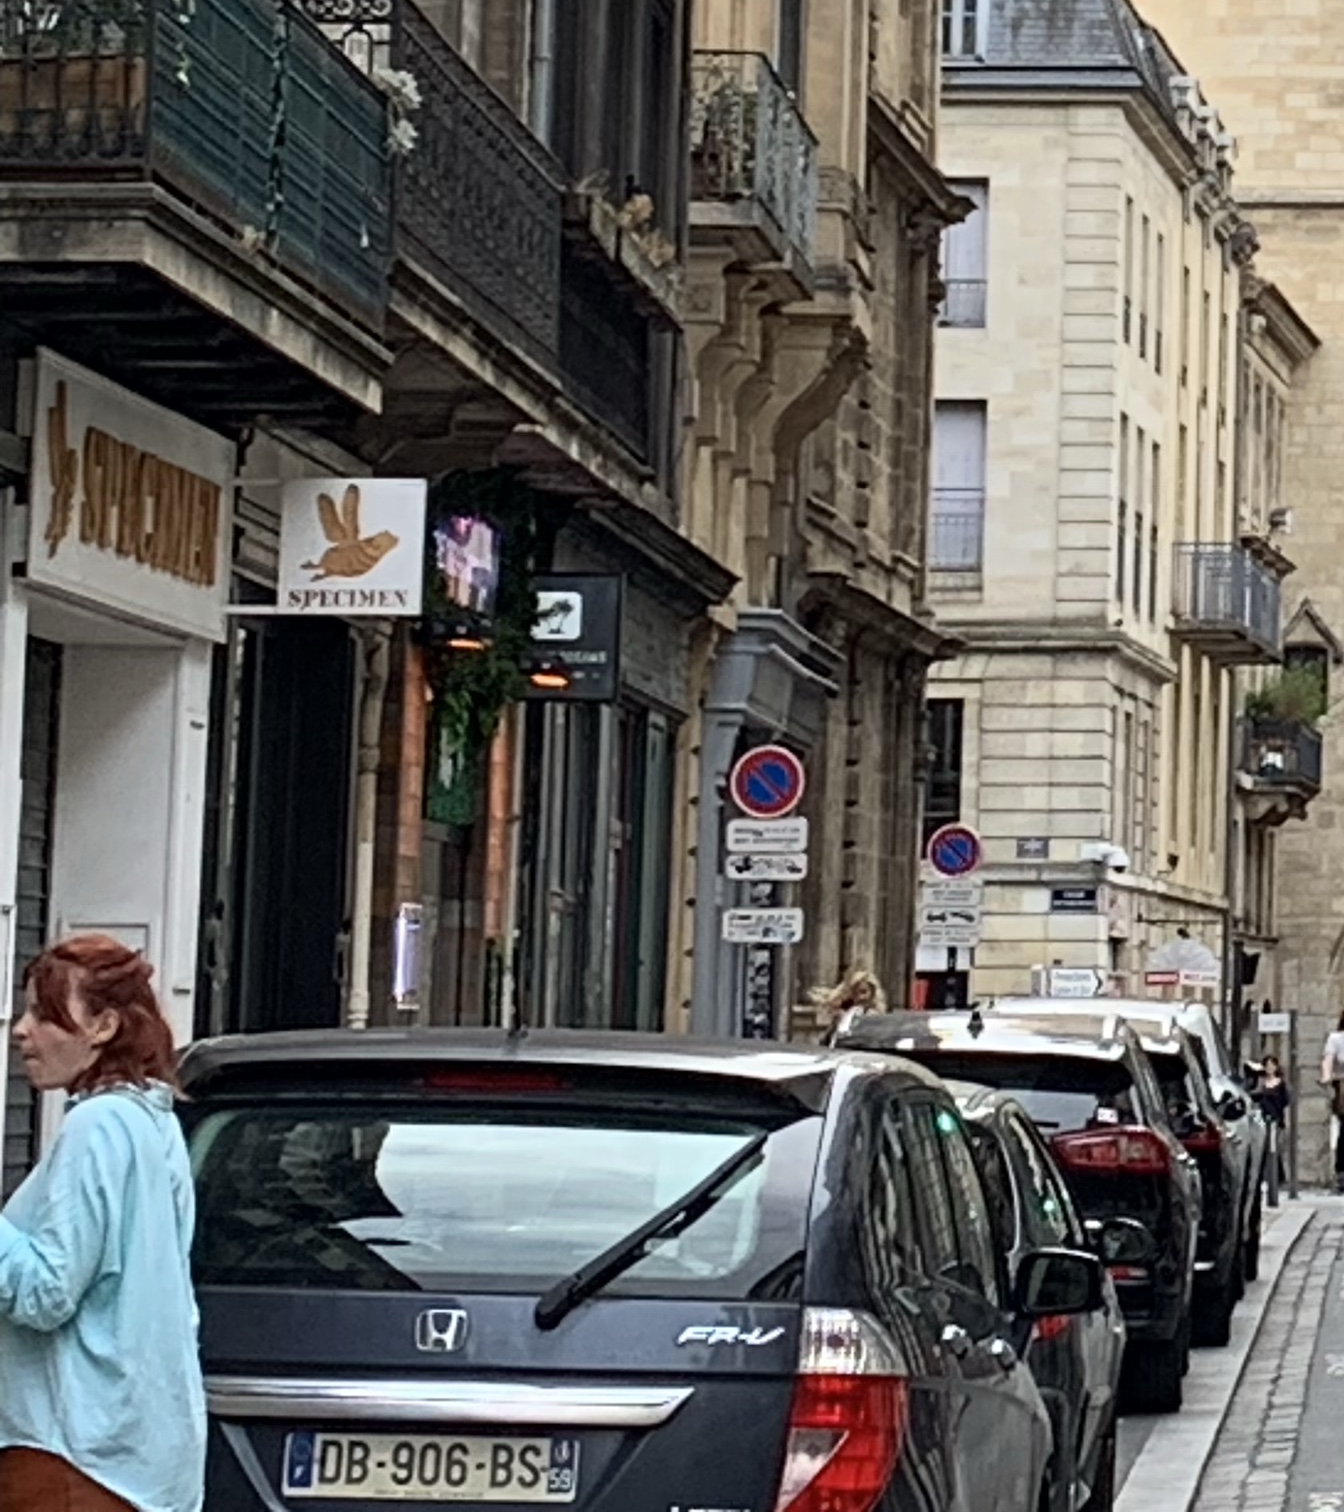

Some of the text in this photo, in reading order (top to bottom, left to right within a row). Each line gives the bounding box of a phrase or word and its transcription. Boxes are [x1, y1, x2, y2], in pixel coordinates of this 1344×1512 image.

[287, 589, 408, 611] SPECIMEN
[677, 1325, 785, 1346] FR-V
[317, 1439, 543, 1489] DB-906-BS
[549, 1468, 572, 1489] 59
